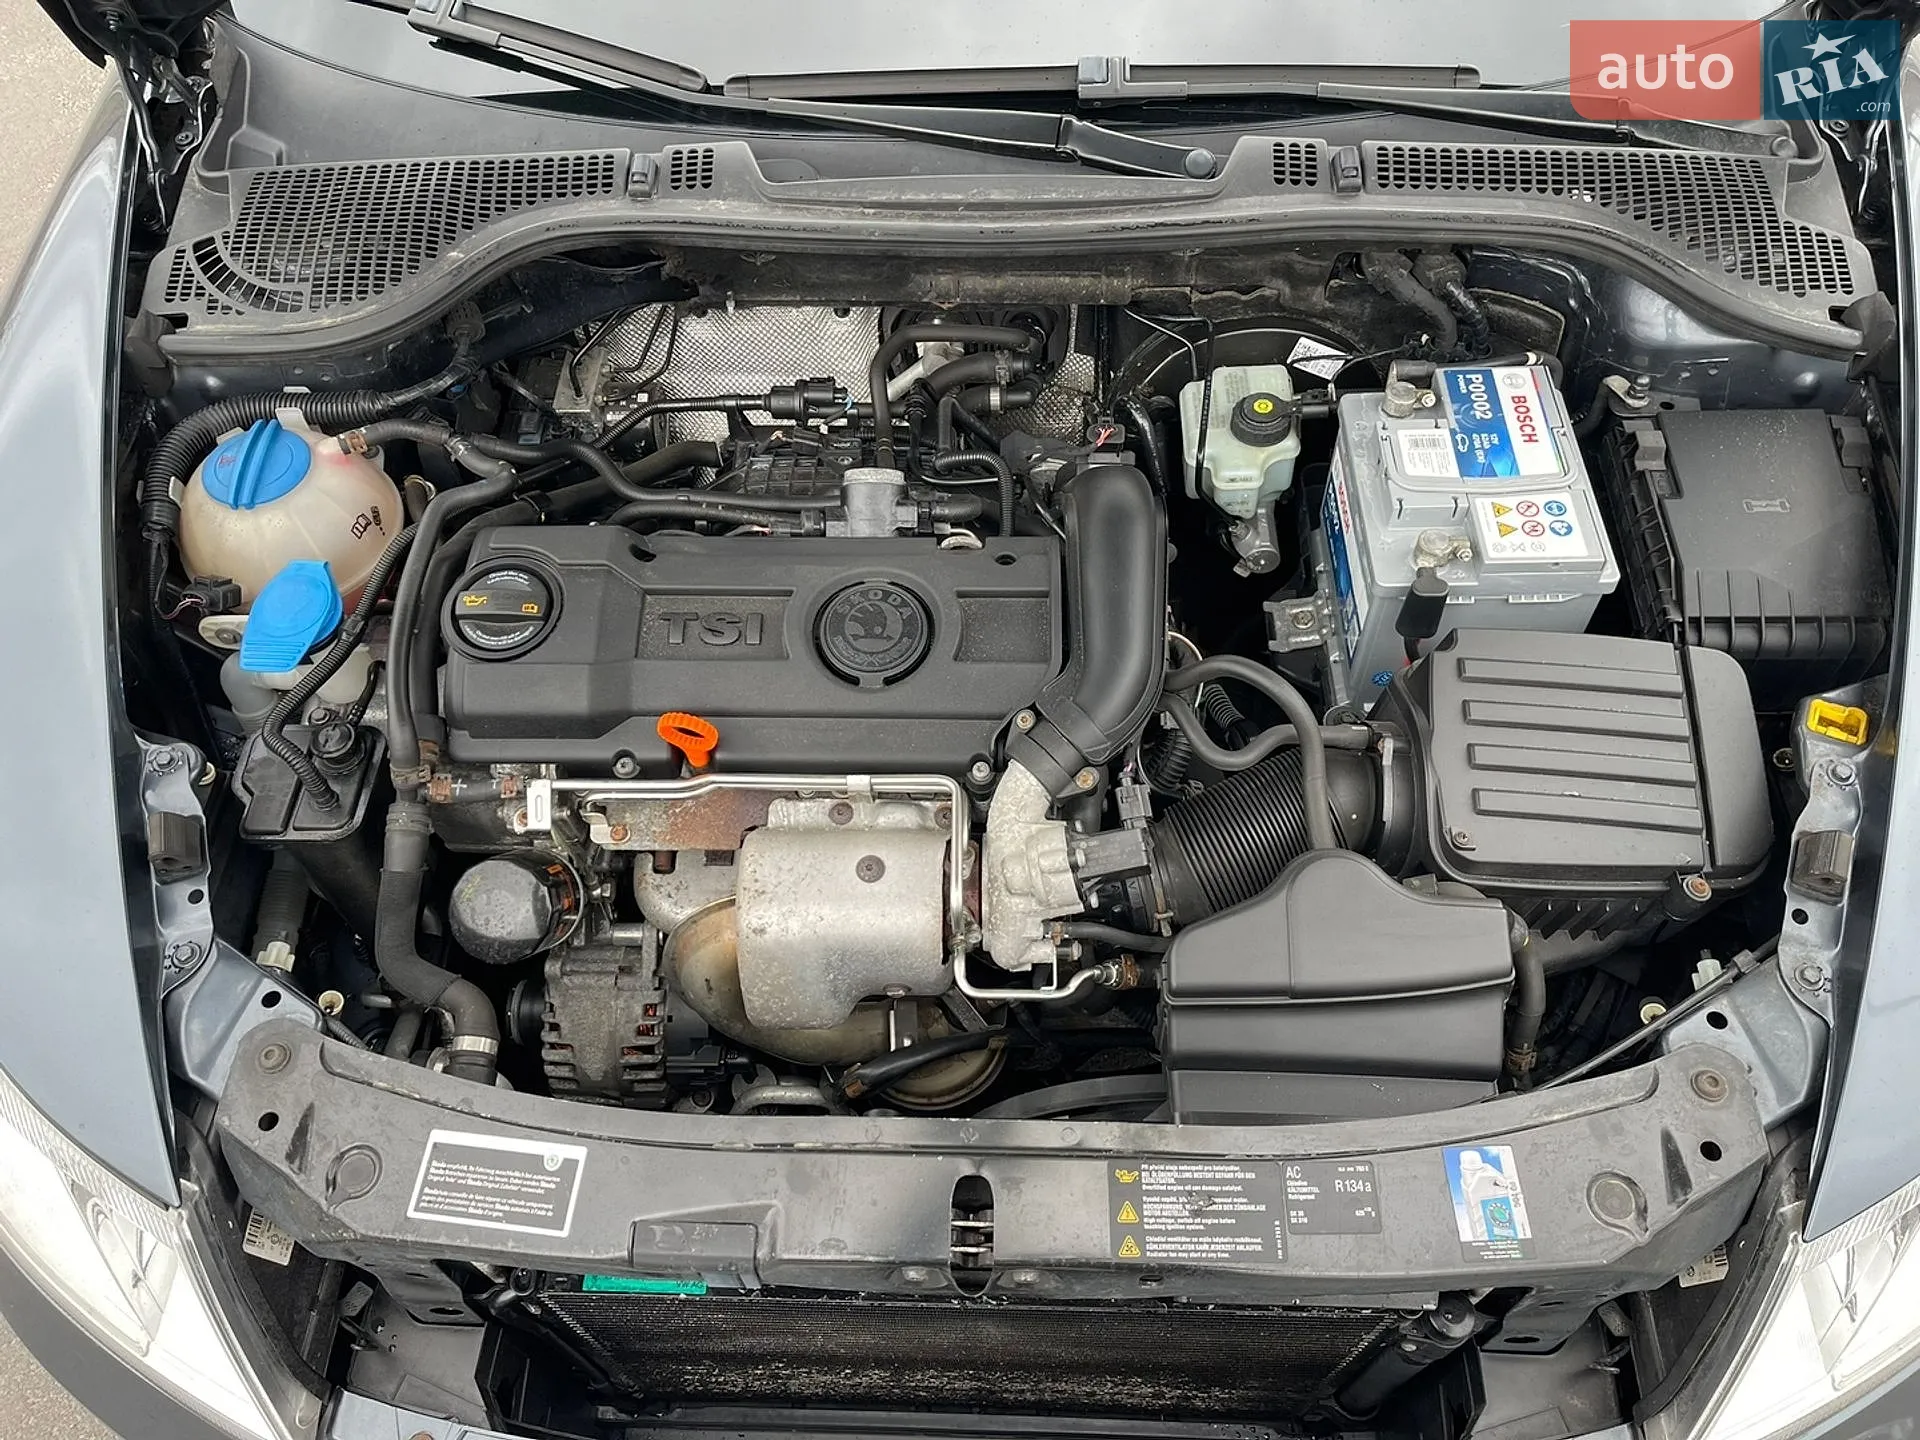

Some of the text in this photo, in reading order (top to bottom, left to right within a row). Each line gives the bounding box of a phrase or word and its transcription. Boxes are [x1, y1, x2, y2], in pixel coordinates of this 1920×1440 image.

[1465, 373, 1493, 420] P0002
[1511, 395, 1539, 444] BOSCH
[659, 612, 764, 646] TSI
[1286, 1166, 1302, 1179] AC
